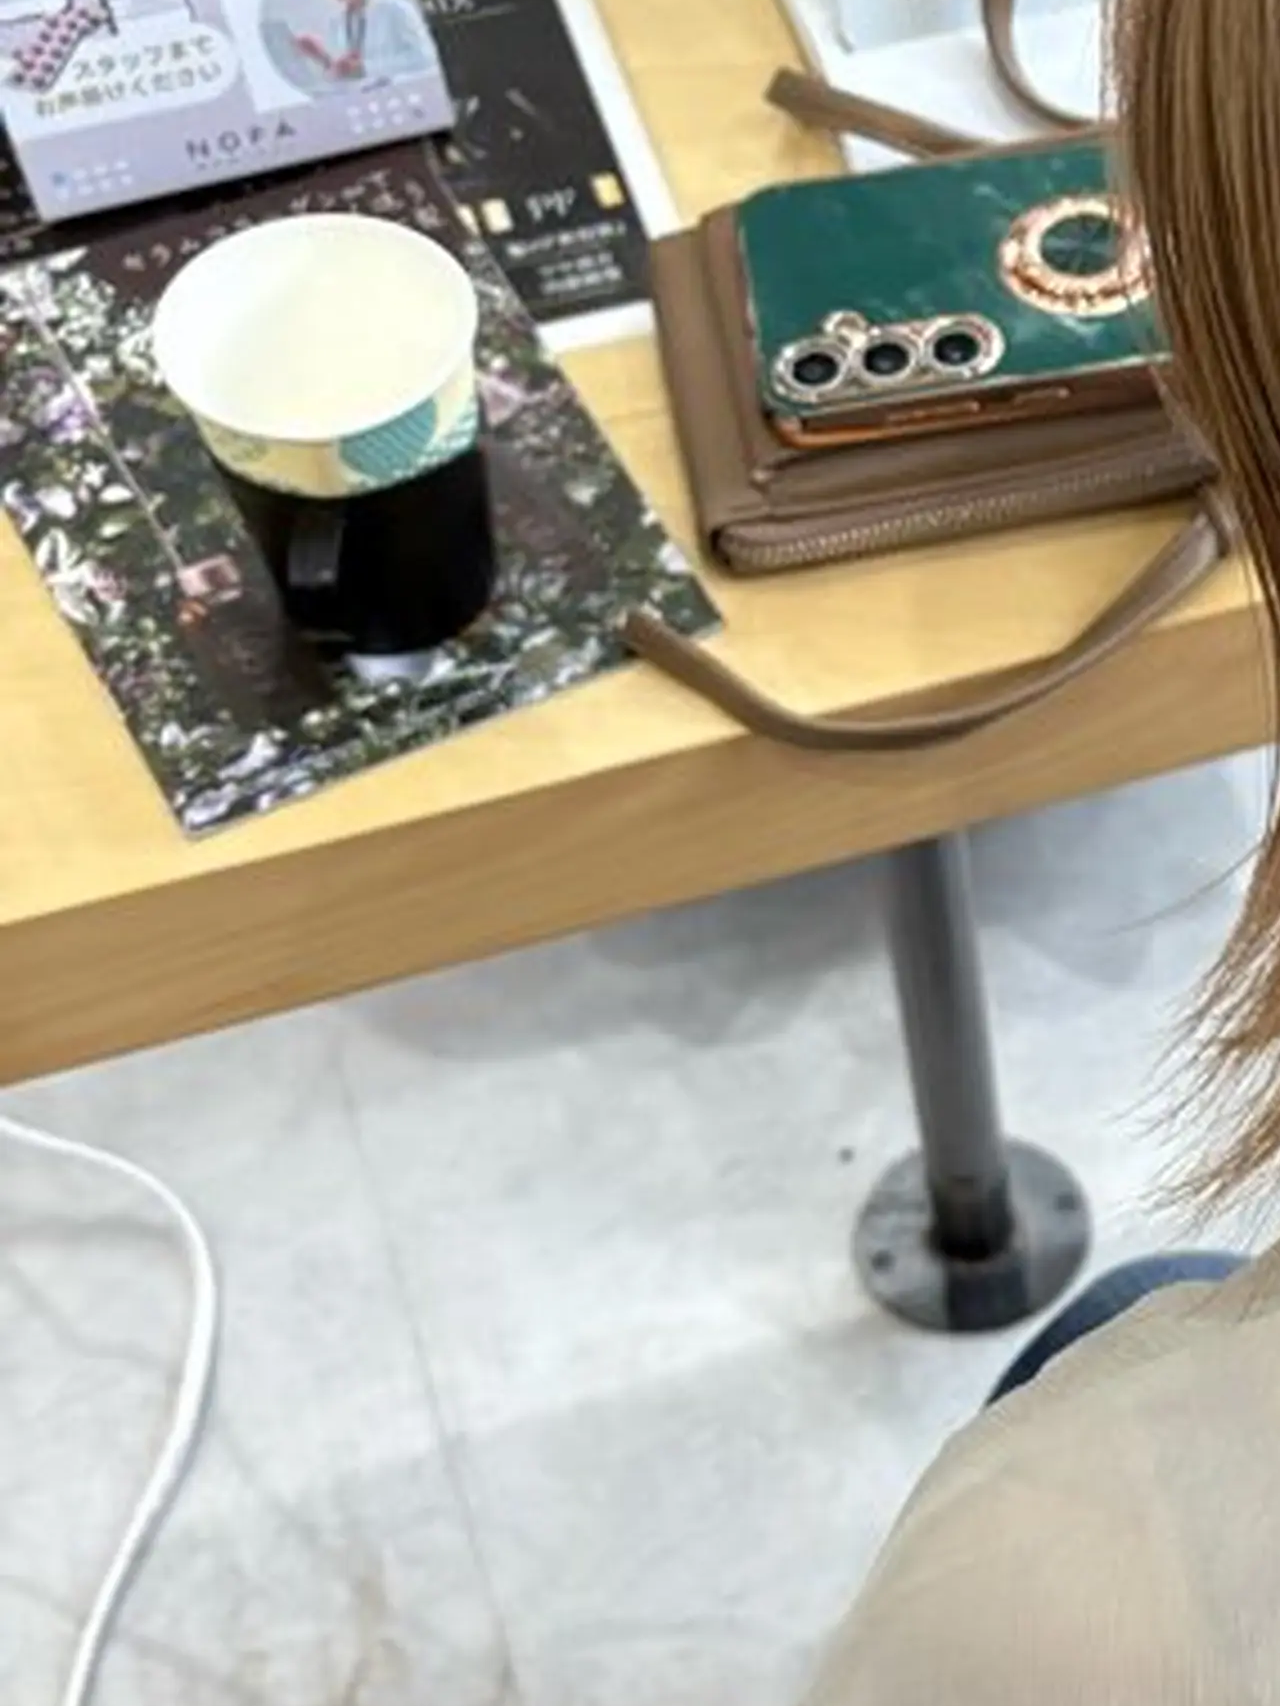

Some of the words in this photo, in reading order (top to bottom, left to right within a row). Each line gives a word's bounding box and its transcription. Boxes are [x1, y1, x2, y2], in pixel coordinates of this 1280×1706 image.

[72, 34, 214, 81] スタッフまで
